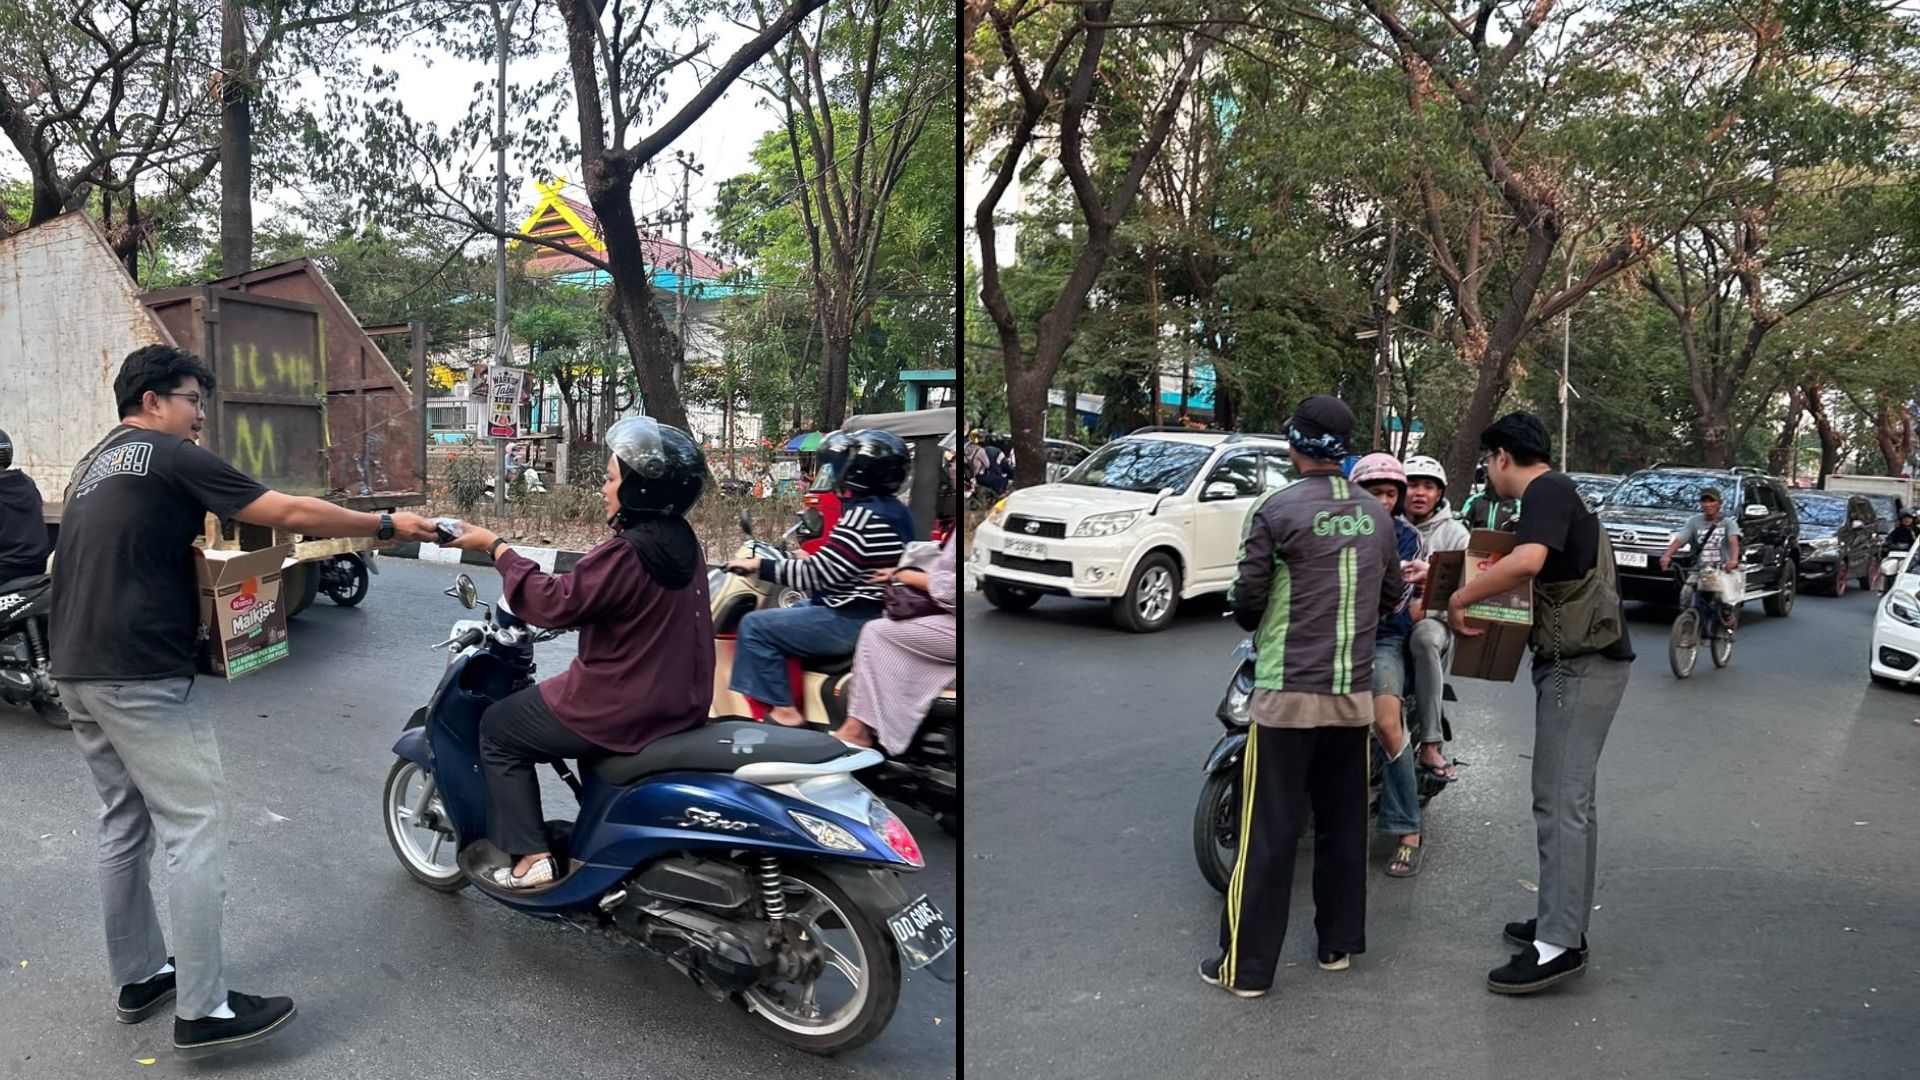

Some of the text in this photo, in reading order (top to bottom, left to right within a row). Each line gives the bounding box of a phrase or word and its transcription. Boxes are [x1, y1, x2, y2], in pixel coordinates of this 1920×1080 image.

[1313, 505, 1375, 536] Grab
[231, 600, 276, 635] Malkist
[232, 598, 254, 610] Roma
[678, 807, 750, 831] Fino
[892, 902, 937, 942] DD 6885
